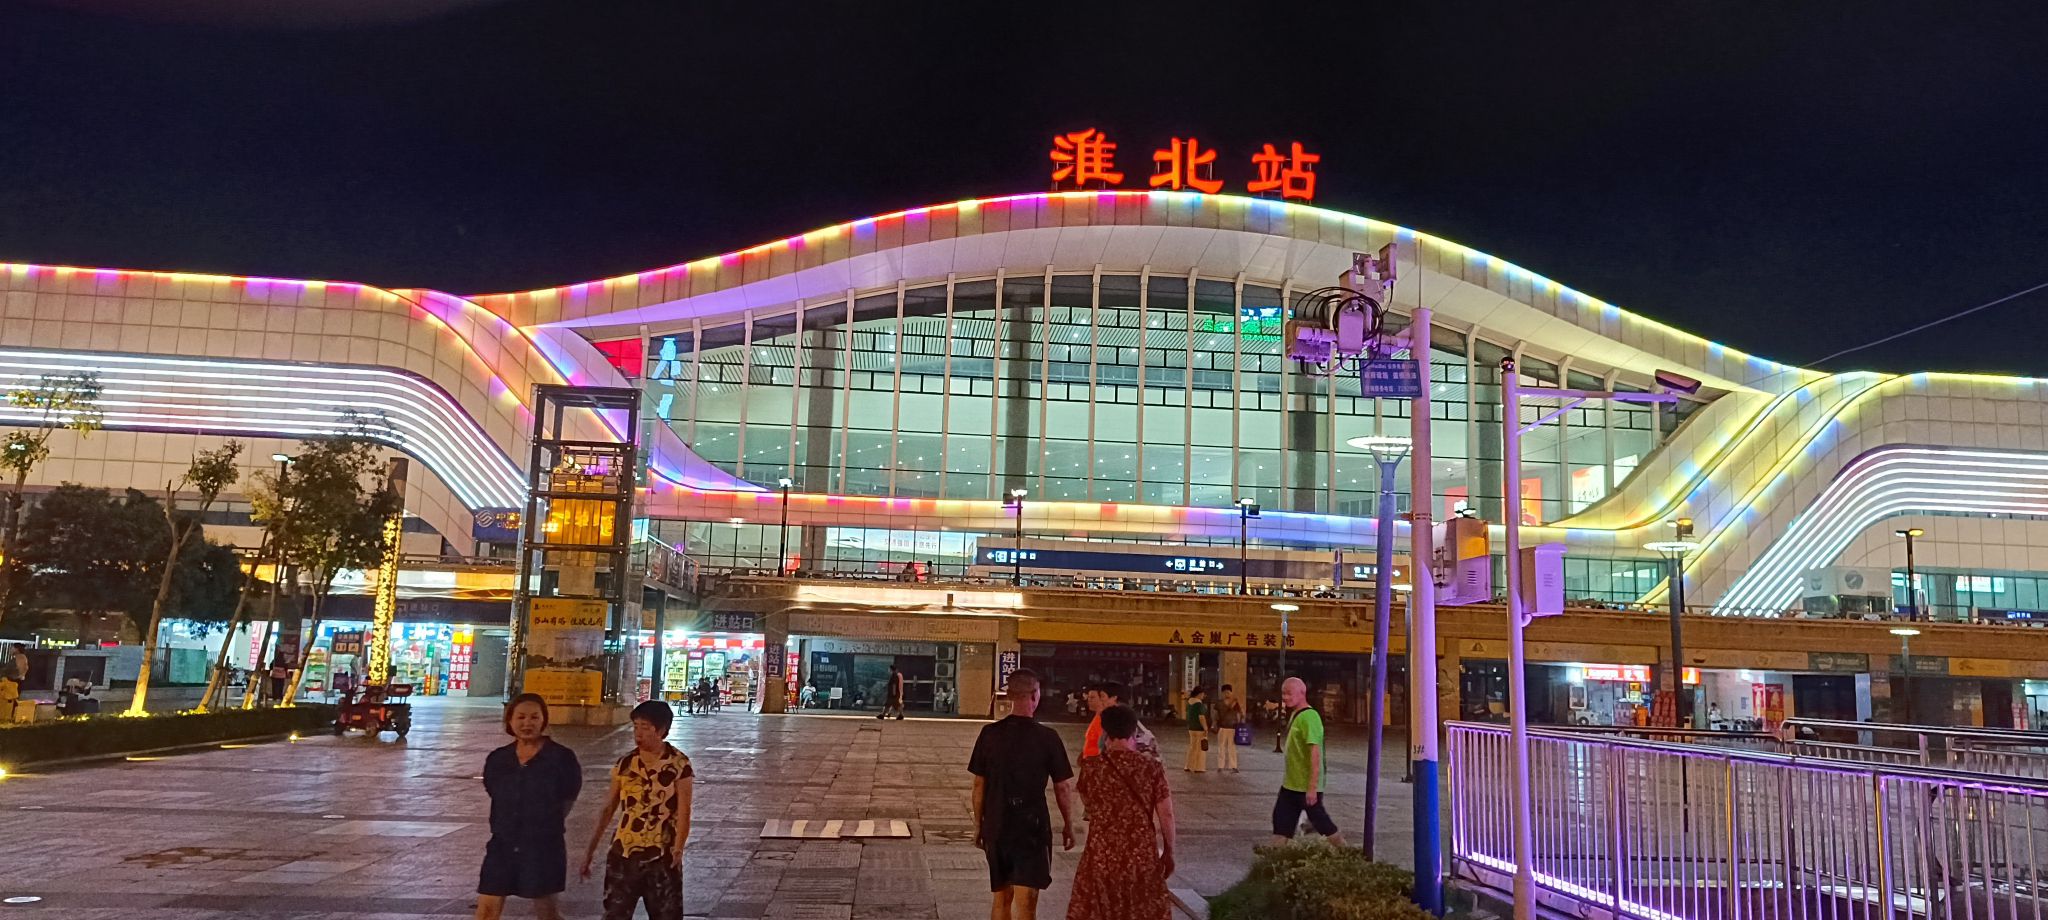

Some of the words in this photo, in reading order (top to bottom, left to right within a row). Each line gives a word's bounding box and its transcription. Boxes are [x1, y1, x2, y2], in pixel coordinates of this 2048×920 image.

[1050, 127, 1320, 200] 淮北站
[714, 614, 755, 629] 进站口
[1191, 630, 1295, 648] 金巢广告装饰
[769, 646, 780, 674] 进站口
